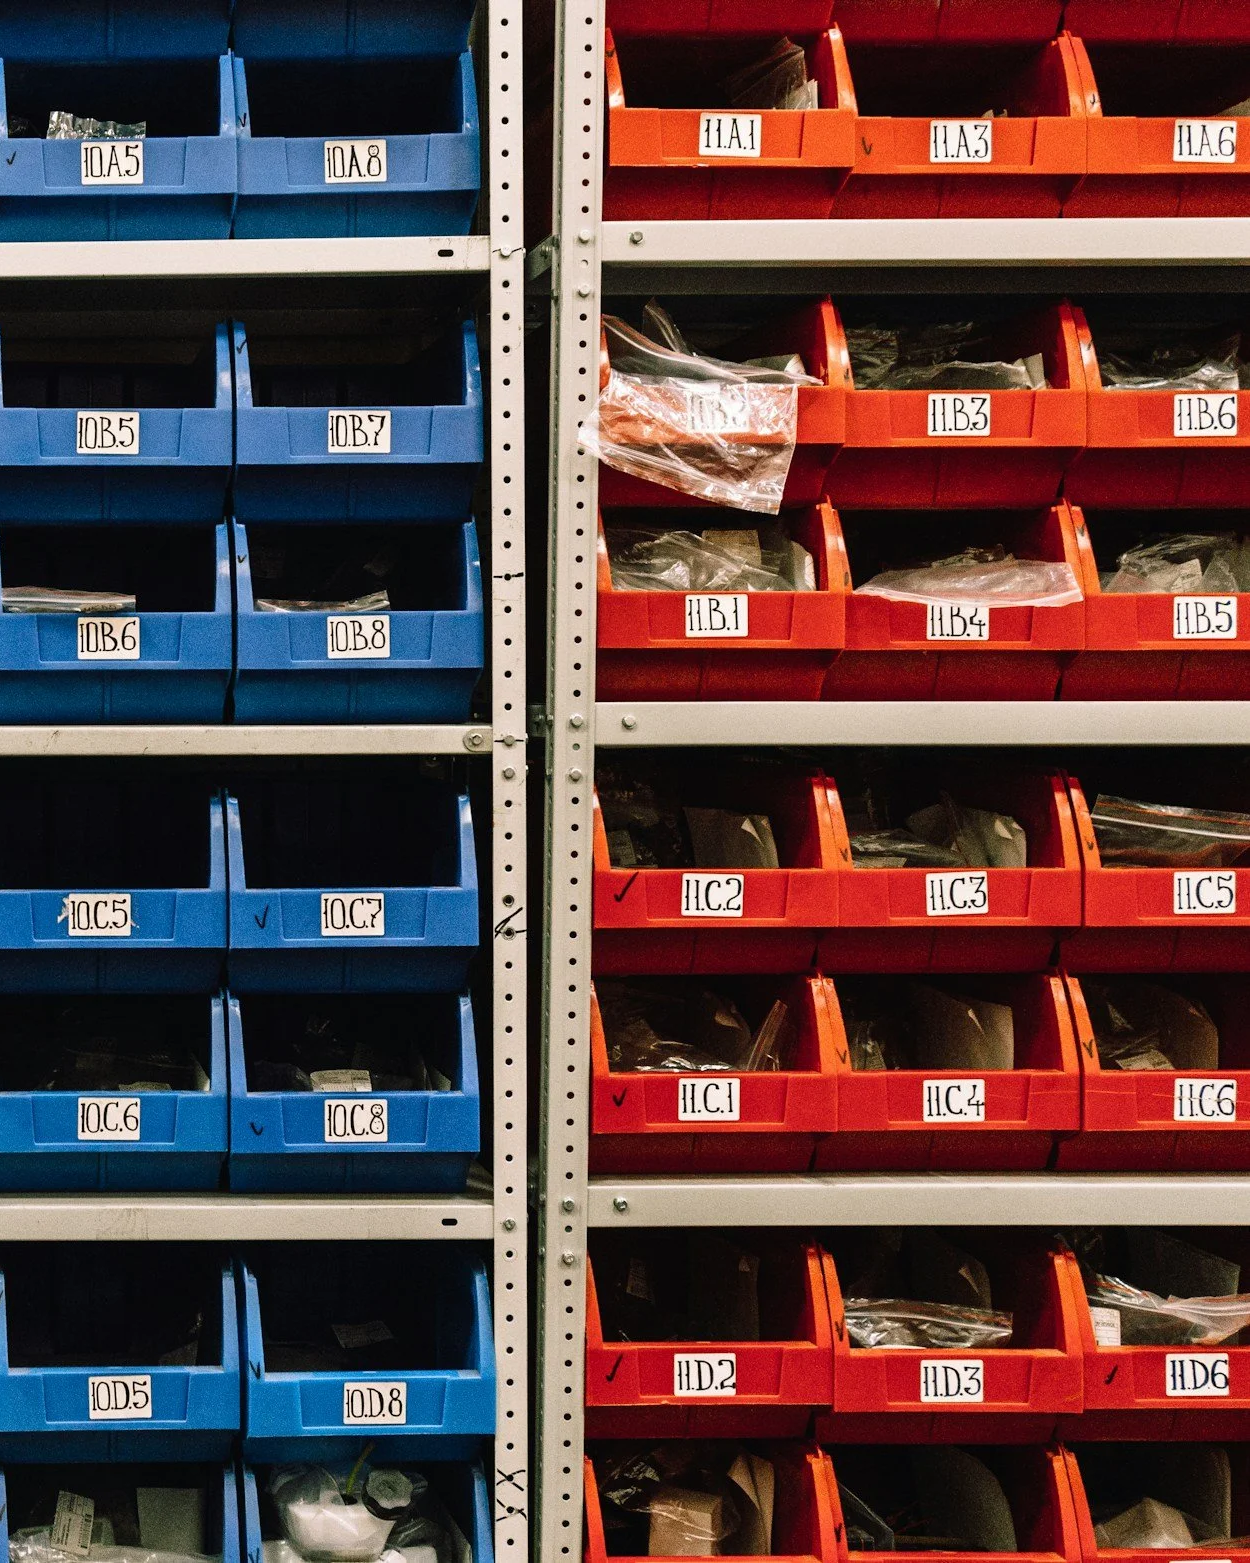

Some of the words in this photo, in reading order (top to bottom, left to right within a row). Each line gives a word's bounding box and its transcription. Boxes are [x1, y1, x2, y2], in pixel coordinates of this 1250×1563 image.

[704, 118, 755, 150] 11.A.1
[933, 125, 988, 158] 11.A.3
[1177, 124, 1235, 156] 11.A.6
[83, 144, 140, 177] 10.A.5
[326, 144, 382, 178] 10.A.8
[330, 414, 386, 447] 10.B.7
[931, 397, 988, 432] 11.B.3
[1177, 397, 1237, 431] 11.B.6
[79, 416, 135, 448] 10.B.5
[688, 598, 739, 631] 11.B.1
[1176, 600, 1233, 634] 11.B.5
[80, 620, 137, 653] 10.B.6
[329, 619, 386, 652] 10.B.8
[684, 878, 742, 911] 11.C.2
[929, 876, 987, 911] 11.C.3
[1177, 876, 1235, 910] 11.C.5
[70, 898, 128, 930] 10.C.5
[323, 897, 382, 930] 10.C.7
[681, 1082, 733, 1114] 11.C.1
[927, 1084, 985, 1117] 11.C.4
[1178, 1083, 1235, 1117] 11.C.6
[80, 1102, 139, 1133] 10.C.6
[327, 1104, 385, 1137] 10.C.8
[678, 1359, 736, 1391] 11.D.2
[923, 1366, 981, 1397] 11.D.3
[91, 1380, 149, 1411] 10.D.5
[346, 1388, 403, 1418] 10.D.8
